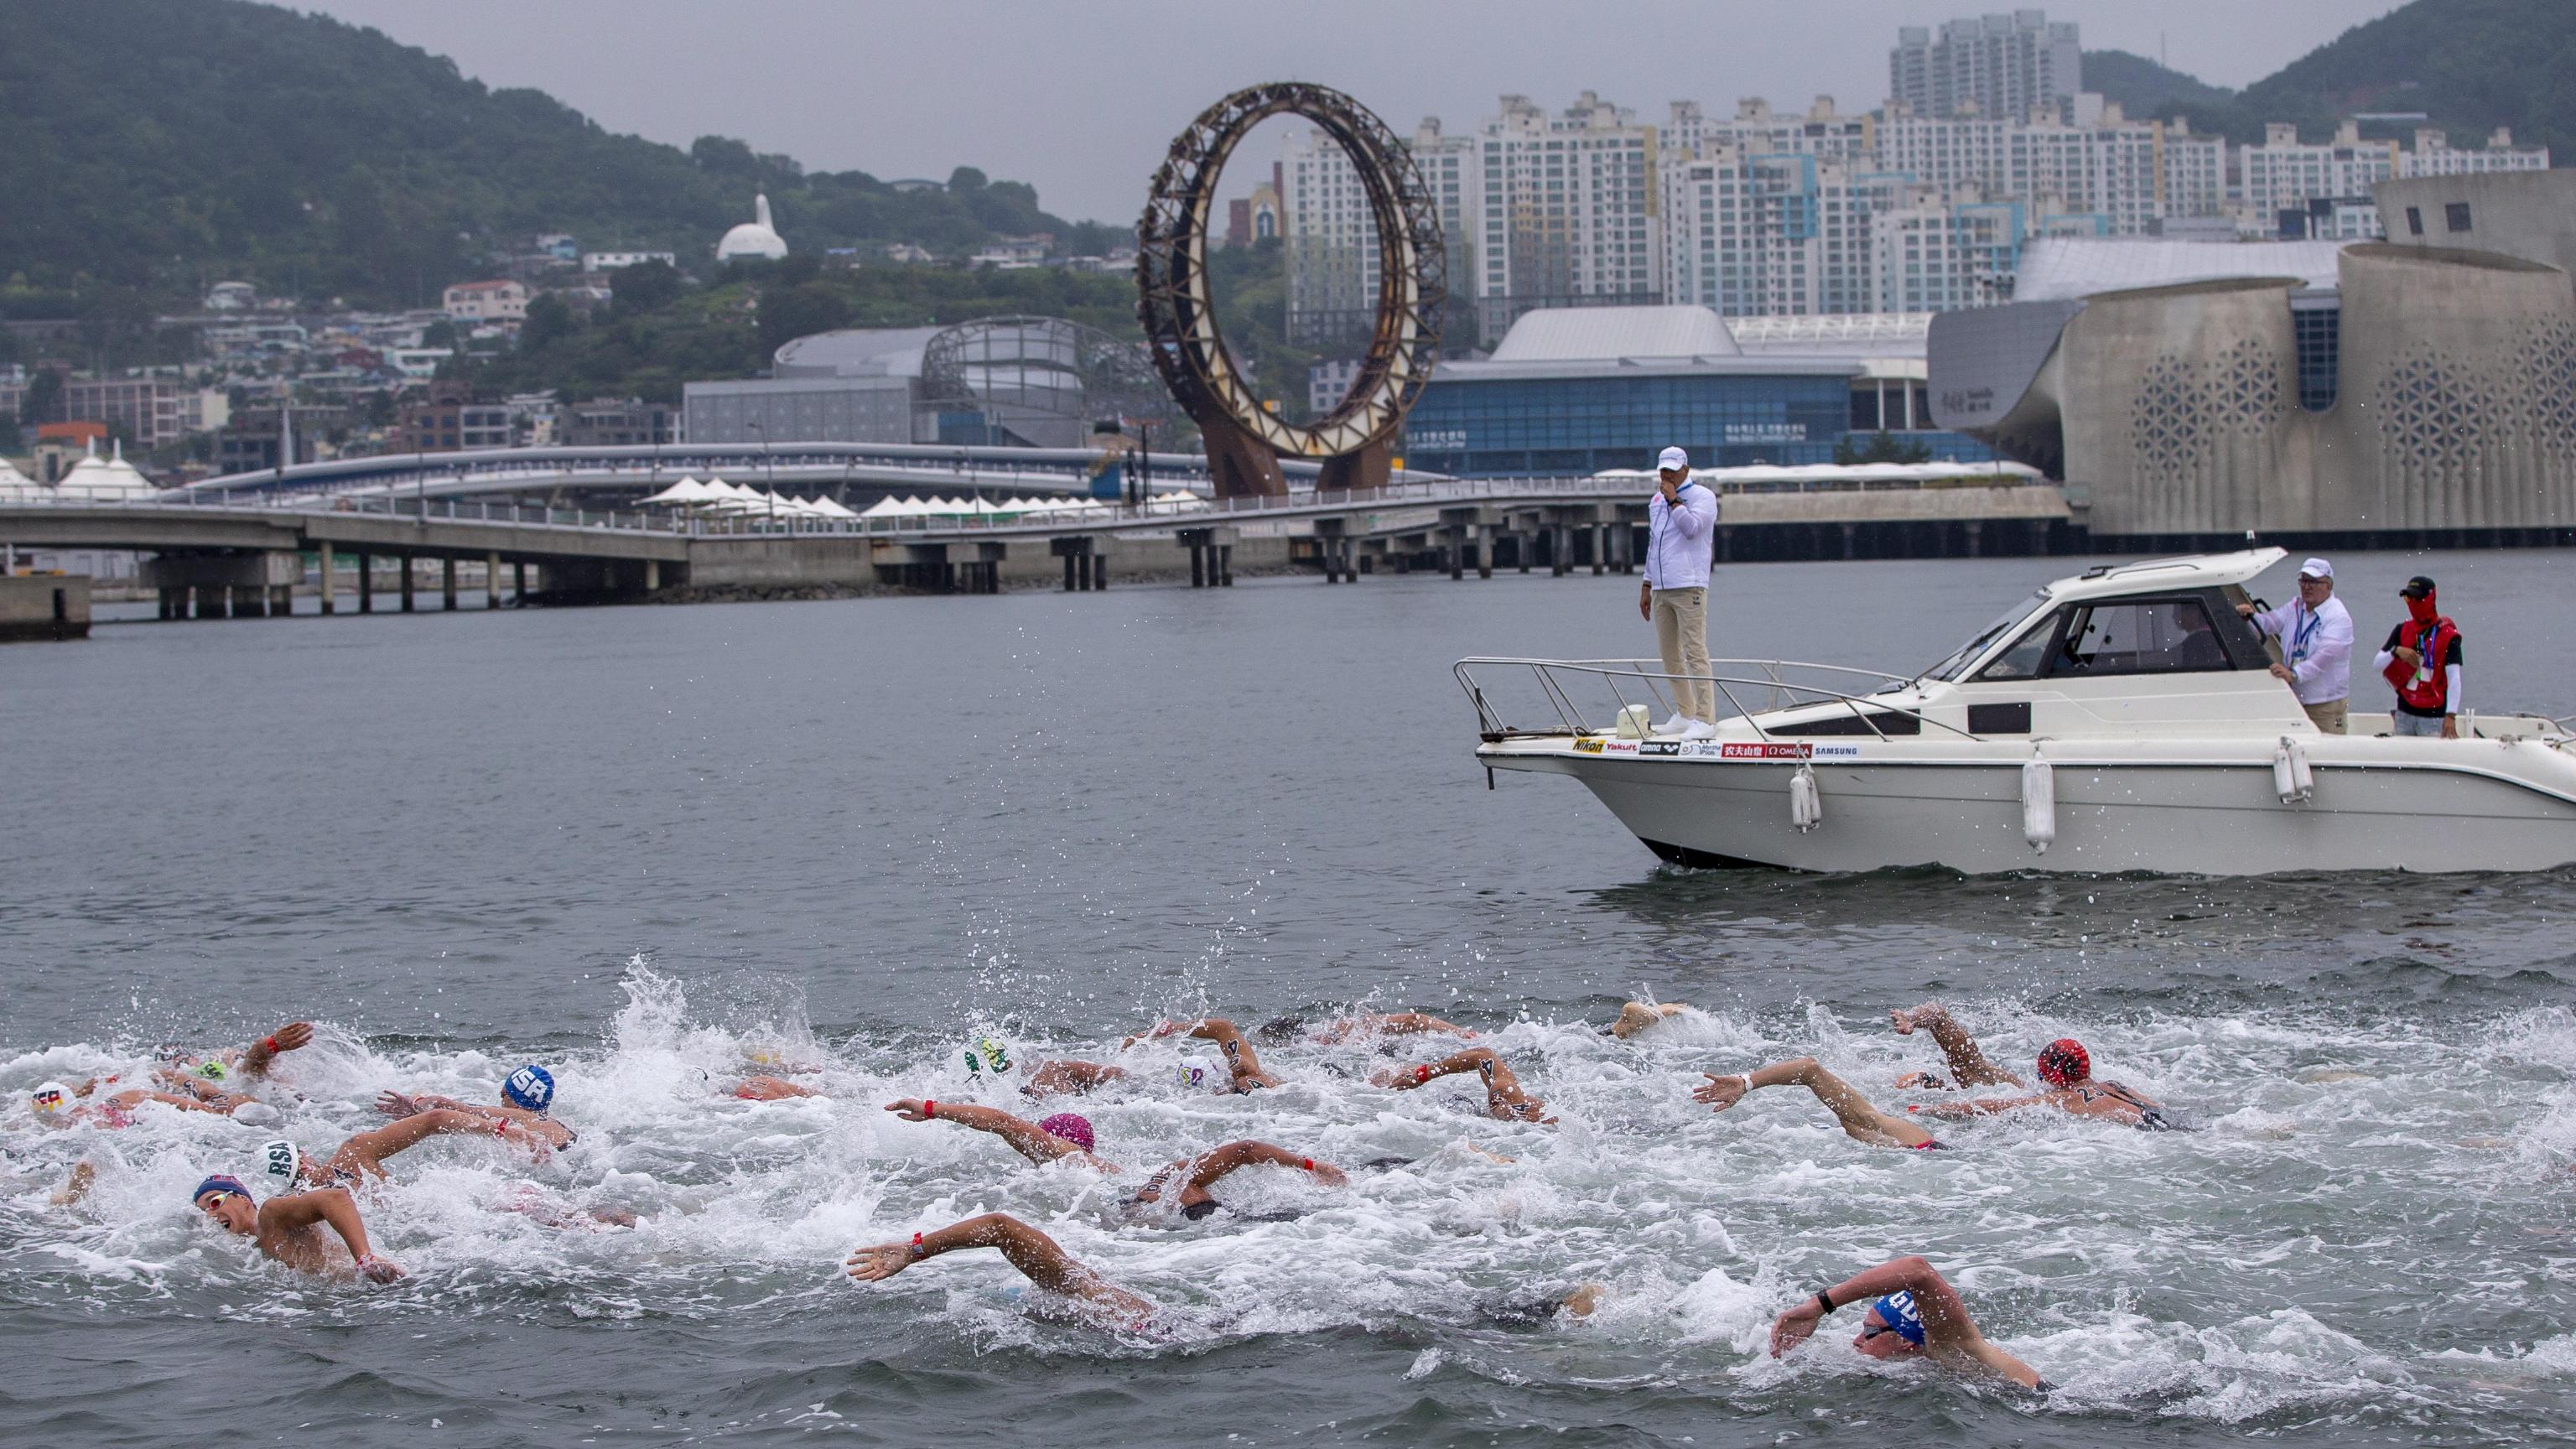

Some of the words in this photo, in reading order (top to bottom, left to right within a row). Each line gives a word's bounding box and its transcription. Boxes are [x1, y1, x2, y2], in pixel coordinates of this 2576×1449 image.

[1573, 739, 1603, 751] Nikon
[1607, 743, 1637, 751] Yakult
[1641, 744, 1660, 752] arena
[511, 1066, 548, 1104] ISR
[267, 1142, 293, 1178] RSA
